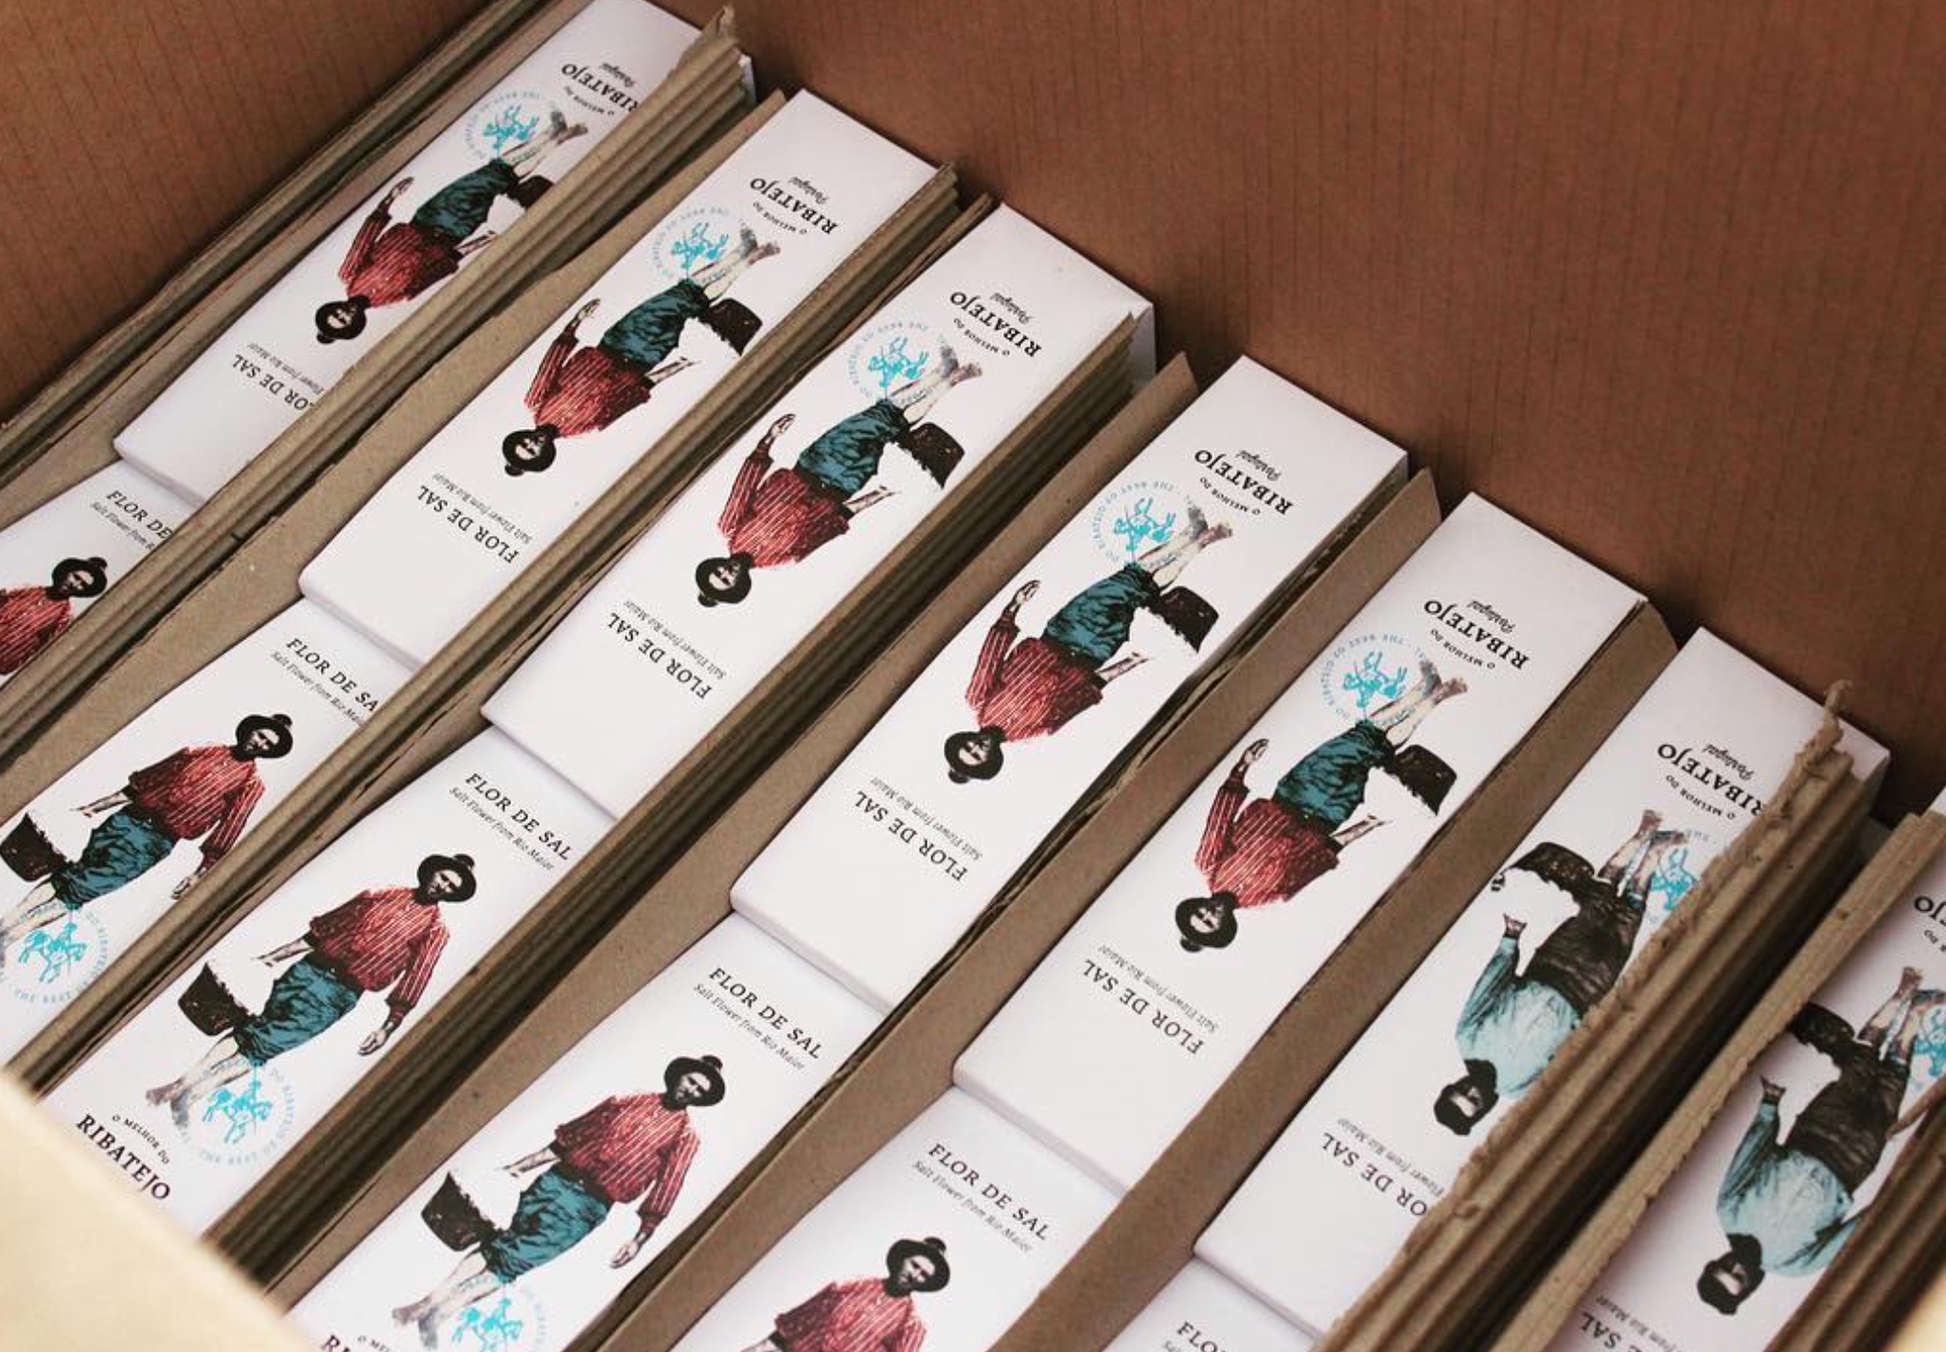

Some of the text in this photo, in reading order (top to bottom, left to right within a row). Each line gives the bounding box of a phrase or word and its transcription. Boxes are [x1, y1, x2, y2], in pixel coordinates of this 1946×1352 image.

[750, 178, 838, 235] RIBATEJO
[752, 201, 764, 212] DO
[788, 176, 828, 204] Portugal
[763, 211, 796, 232] MELHOR
[949, 291, 1042, 357] RIBATEJO
[953, 317, 965, 329] DO
[989, 292, 1032, 324] Portugal
[963, 329, 999, 353] MELHOR
[232, 354, 261, 378] SAL
[259, 373, 285, 395] DE
[1194, 449, 1293, 515] RIBATEJO
[1199, 476, 1212, 489] DO
[1235, 449, 1281, 481] Portugal
[106, 490, 175, 544] FLOR DE
[1211, 488, 1249, 512] MELHOR
[417, 485, 519, 564] FLOR DE SAL
[1423, 600, 1529, 669] RIBATEJO
[1430, 629, 1443, 642] DO
[1466, 600, 1516, 634] Portugal
[607, 612, 712, 699] FLOR DE SAL
[1442, 640, 1483, 667] MELHOR
[286, 638, 378, 712] FLOR DE SA
[1657, 743, 1762, 816] RIBATEJO
[1702, 744, 1754, 781] Portugal
[1665, 774, 1736, 820] O MELHOR DO
[465, 772, 571, 860] FLOR DE SAL
[855, 790, 968, 881] FLOR DE SAL
[1923, 929, 1939, 944] DO
[709, 967, 821, 1059] FLOR DE SAL
[1083, 959, 1204, 1054] FLOR DE SAL
[76, 1113, 170, 1199] RIBATEJO
[111, 1114, 170, 1164] O MELHOR DO
[1322, 1132, 1360, 1167] SAL
[928, 1143, 1048, 1240] FLOR DE SAL
[1360, 1163, 1393, 1192] DE
[1176, 1321, 1218, 1352] FLO
[1580, 1307, 1621, 1348] SAL
